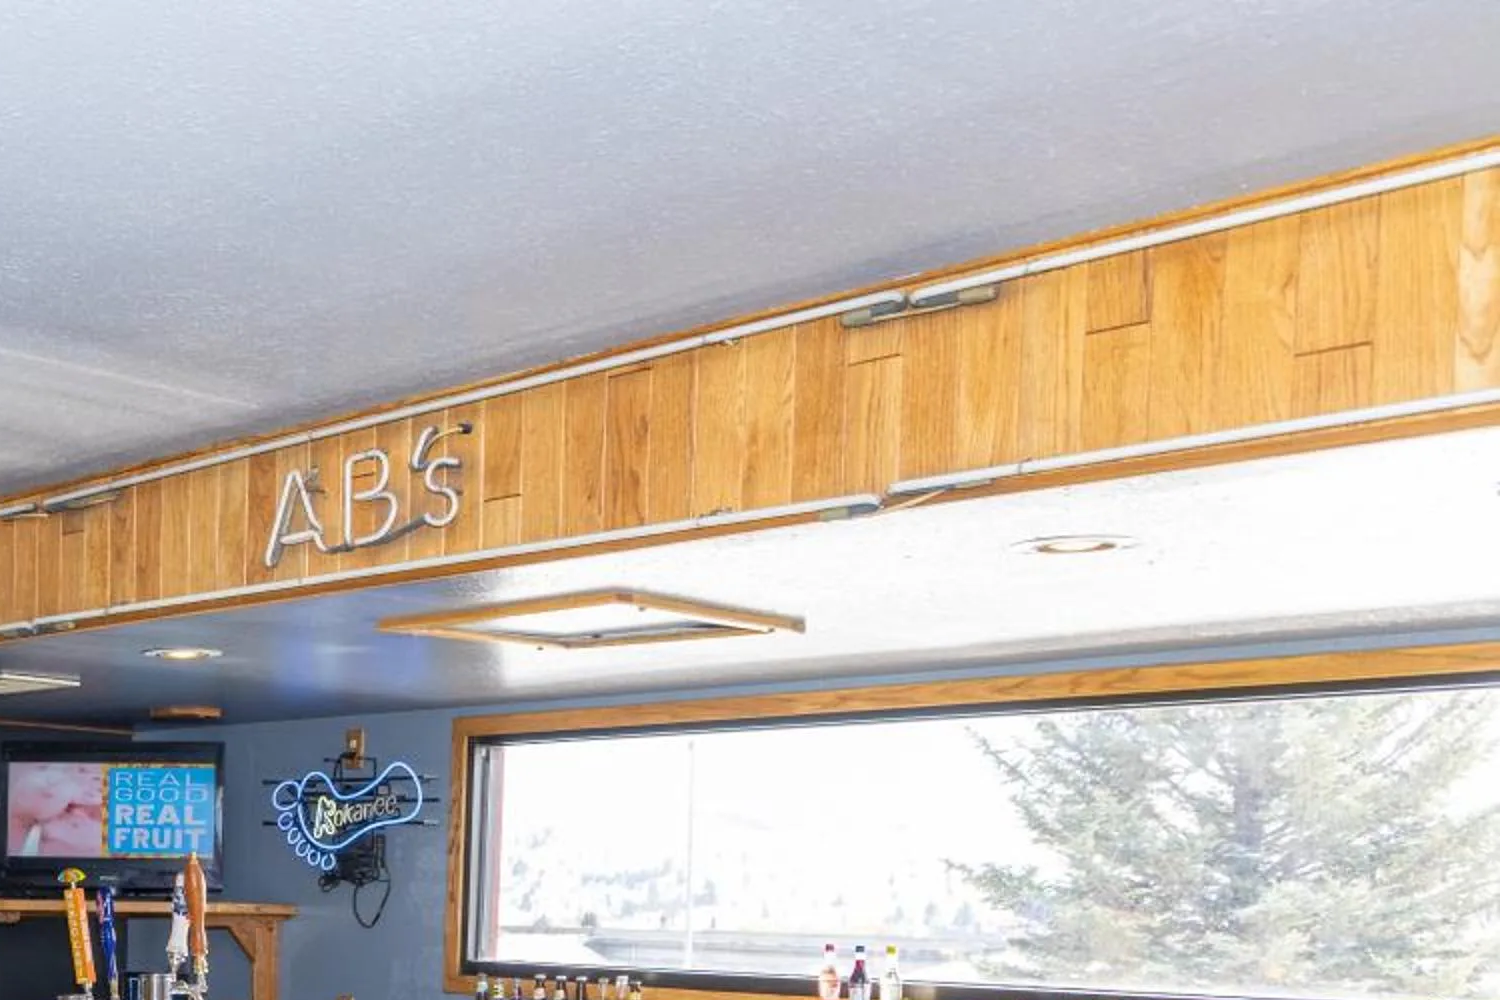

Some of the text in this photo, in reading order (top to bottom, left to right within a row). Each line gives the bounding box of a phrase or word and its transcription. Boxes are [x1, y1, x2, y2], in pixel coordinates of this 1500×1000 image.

[115, 771, 207, 787] REAL
[115, 787, 208, 802] GOOD
[115, 803, 206, 825] REAL
[313, 794, 398, 839] Kokanee
[115, 828, 206, 849] FRUIT
